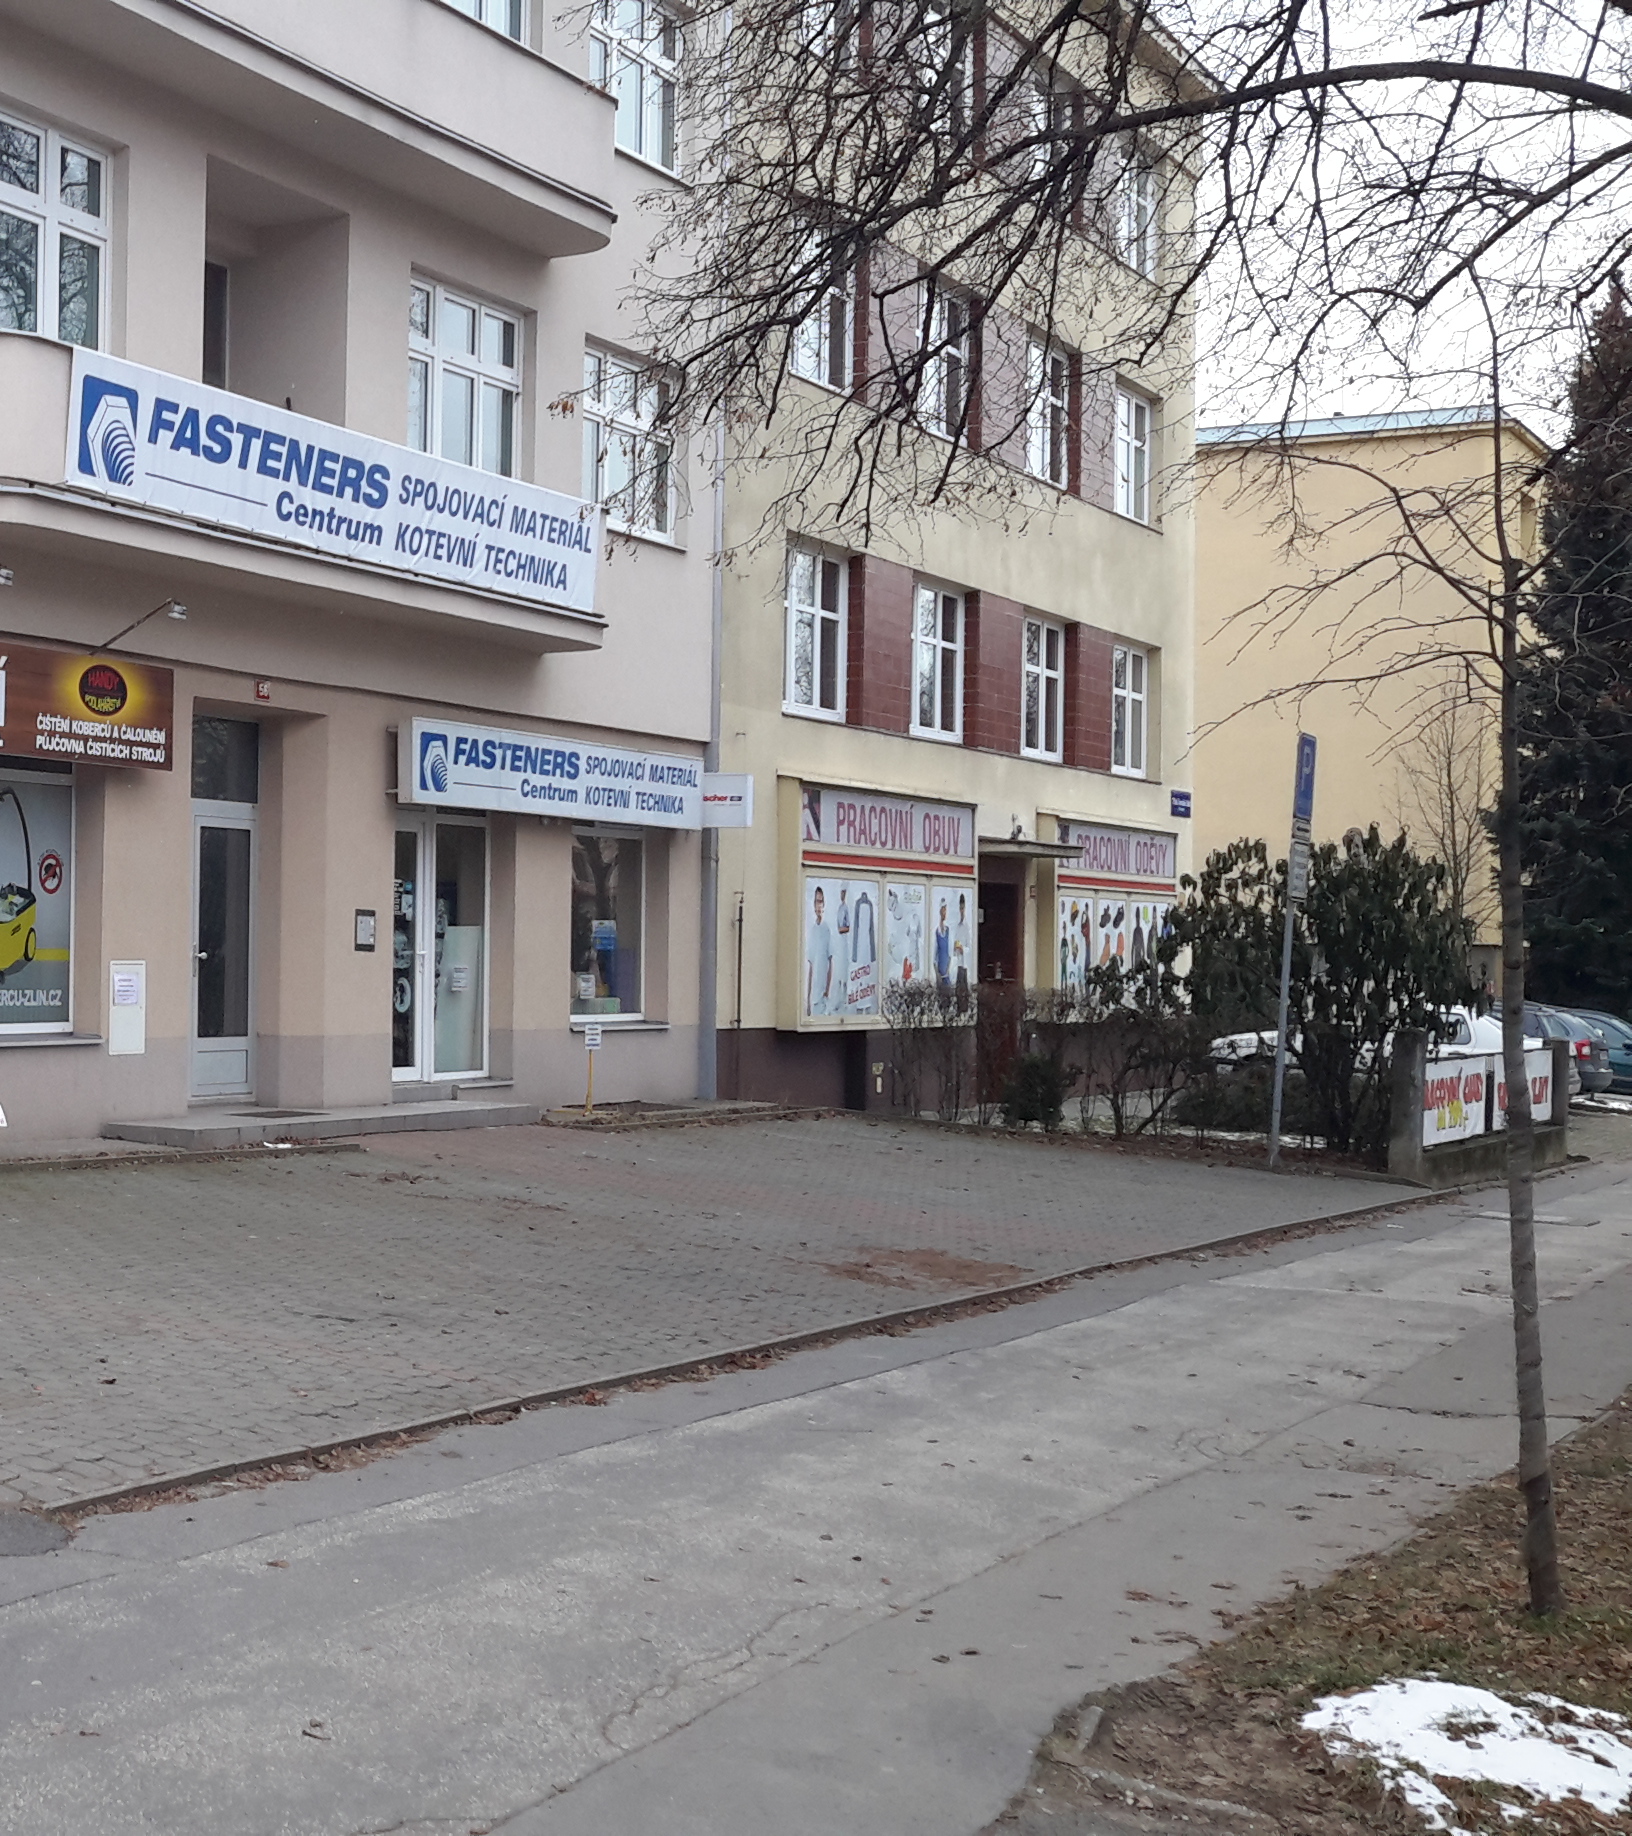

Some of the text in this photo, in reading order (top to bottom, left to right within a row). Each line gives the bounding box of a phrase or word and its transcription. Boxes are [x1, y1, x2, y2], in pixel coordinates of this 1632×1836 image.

[147, 396, 391, 510] FASTENERS
[275, 490, 384, 547] Centrum
[398, 474, 592, 554] SPOJOVACÍ MATERIÁL
[394, 521, 568, 592] KOTEVNÍ TECHNIKA
[35, 732, 166, 763] PŮJČOVNA ČISTÍCÍCH STROJŮ
[36, 712, 166, 745] ČIŠTĚNÍ KOBERCŮ A ČALOUNĚNÍ
[452, 736, 581, 780] FASTENERS
[584, 755, 698, 788] SPOJOVACÍ MATERIÁL
[520, 778, 578, 803] Centrum
[584, 785, 684, 815] KOTEVNÍ TECHNIKA
[836, 802, 961, 856] PRACOVNÍ OBUV
[1076, 833, 1168, 875] PRACOVNÍ ODĚVY
